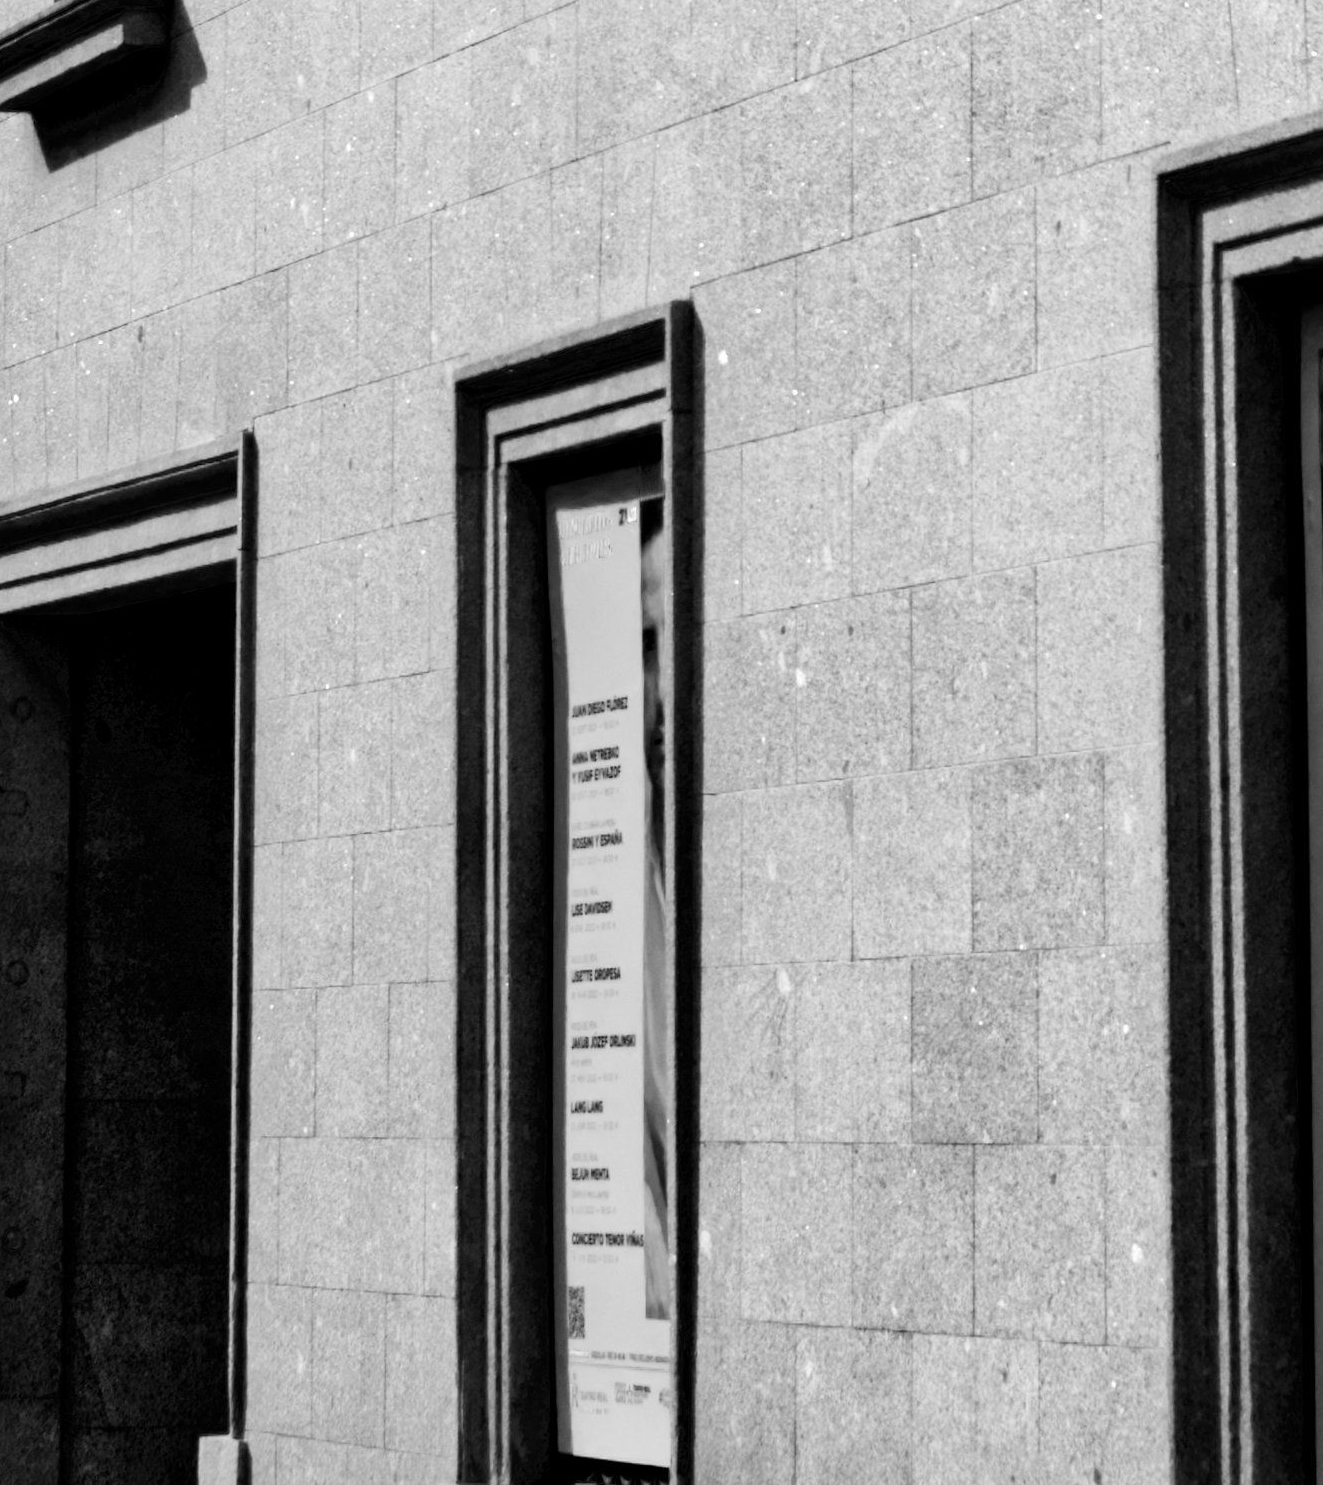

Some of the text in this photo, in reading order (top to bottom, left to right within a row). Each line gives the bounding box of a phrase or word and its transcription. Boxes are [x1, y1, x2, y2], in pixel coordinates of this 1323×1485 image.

[571, 704, 587, 718] JUAN
[588, 701, 606, 716] DIEGO
[571, 746, 620, 764] ANNA NETREBKO
[600, 829, 624, 847] ESPAÑA
[570, 900, 614, 917] LISE DAVIDSEN
[570, 966, 622, 983] LISETTE OROPESA
[571, 1035, 589, 1050] JAKUB
[570, 1100, 604, 1114] LANG LANG
[590, 1167, 610, 1181] MEHTA
[571, 1232, 604, 1246] CONCIERTO
[604, 1233, 625, 1247] TENOR
